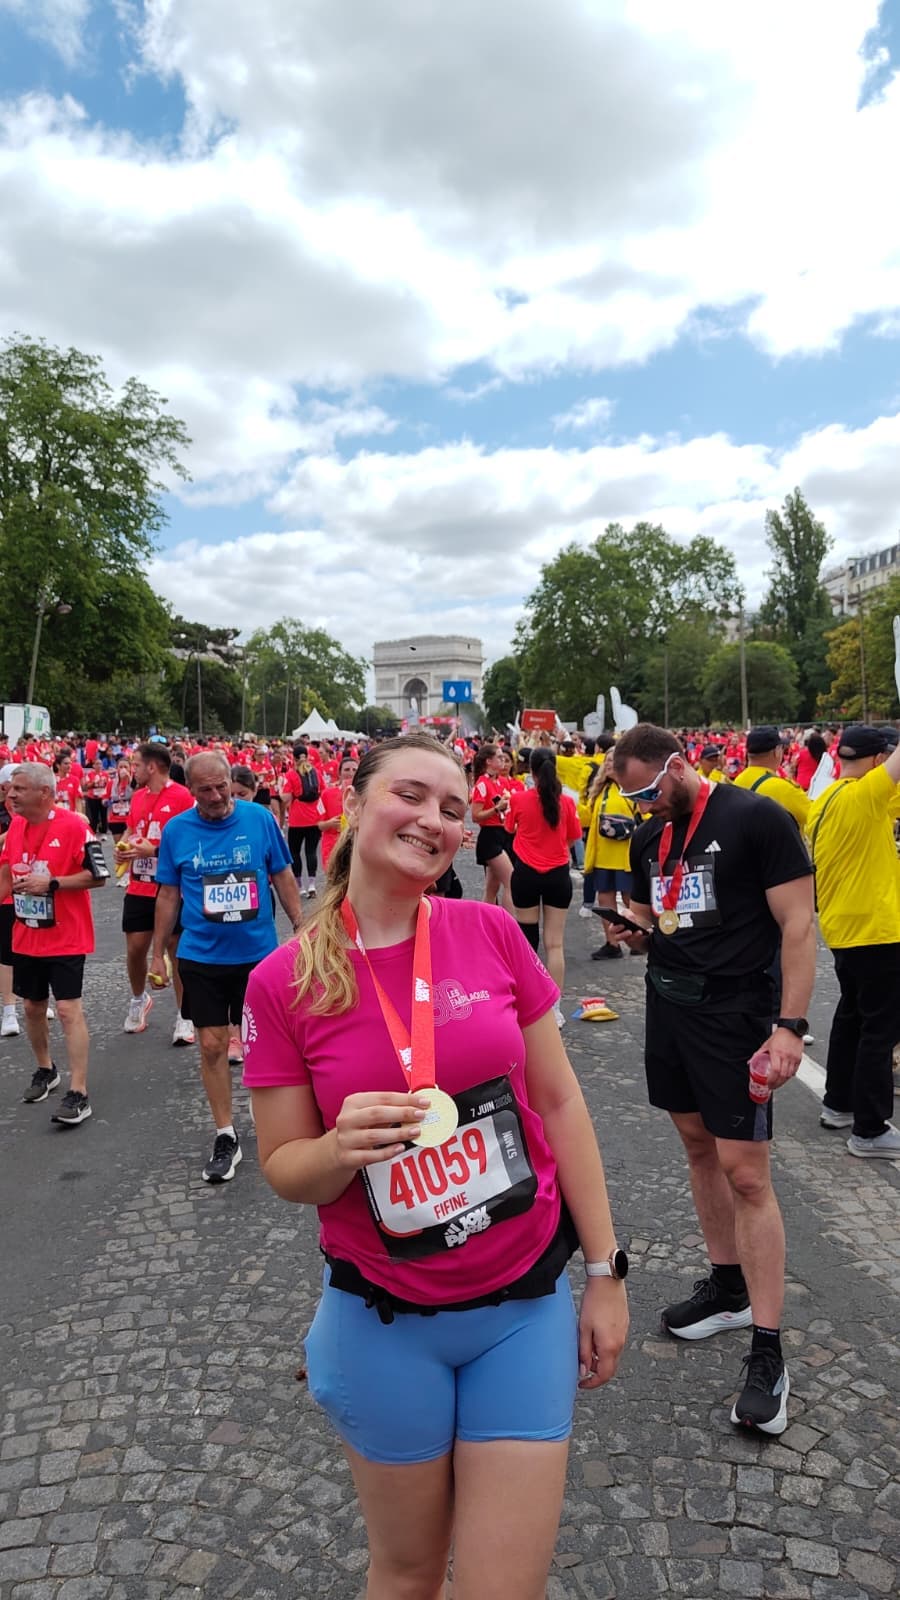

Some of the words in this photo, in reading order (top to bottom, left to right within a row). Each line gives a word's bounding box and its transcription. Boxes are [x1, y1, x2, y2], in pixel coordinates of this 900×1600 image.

[208, 885, 248, 903] 45649
[16, 898, 45, 916] 3934
[447, 988, 460, 1000] LES
[470, 1109, 477, 1118] 7
[477, 1101, 495, 1115] JUIN
[502, 1130, 515, 1149] MIN
[506, 1148, 518, 1160] 57
[389, 1127, 487, 1210] 41059
[434, 1191, 470, 1220] FIFINE
